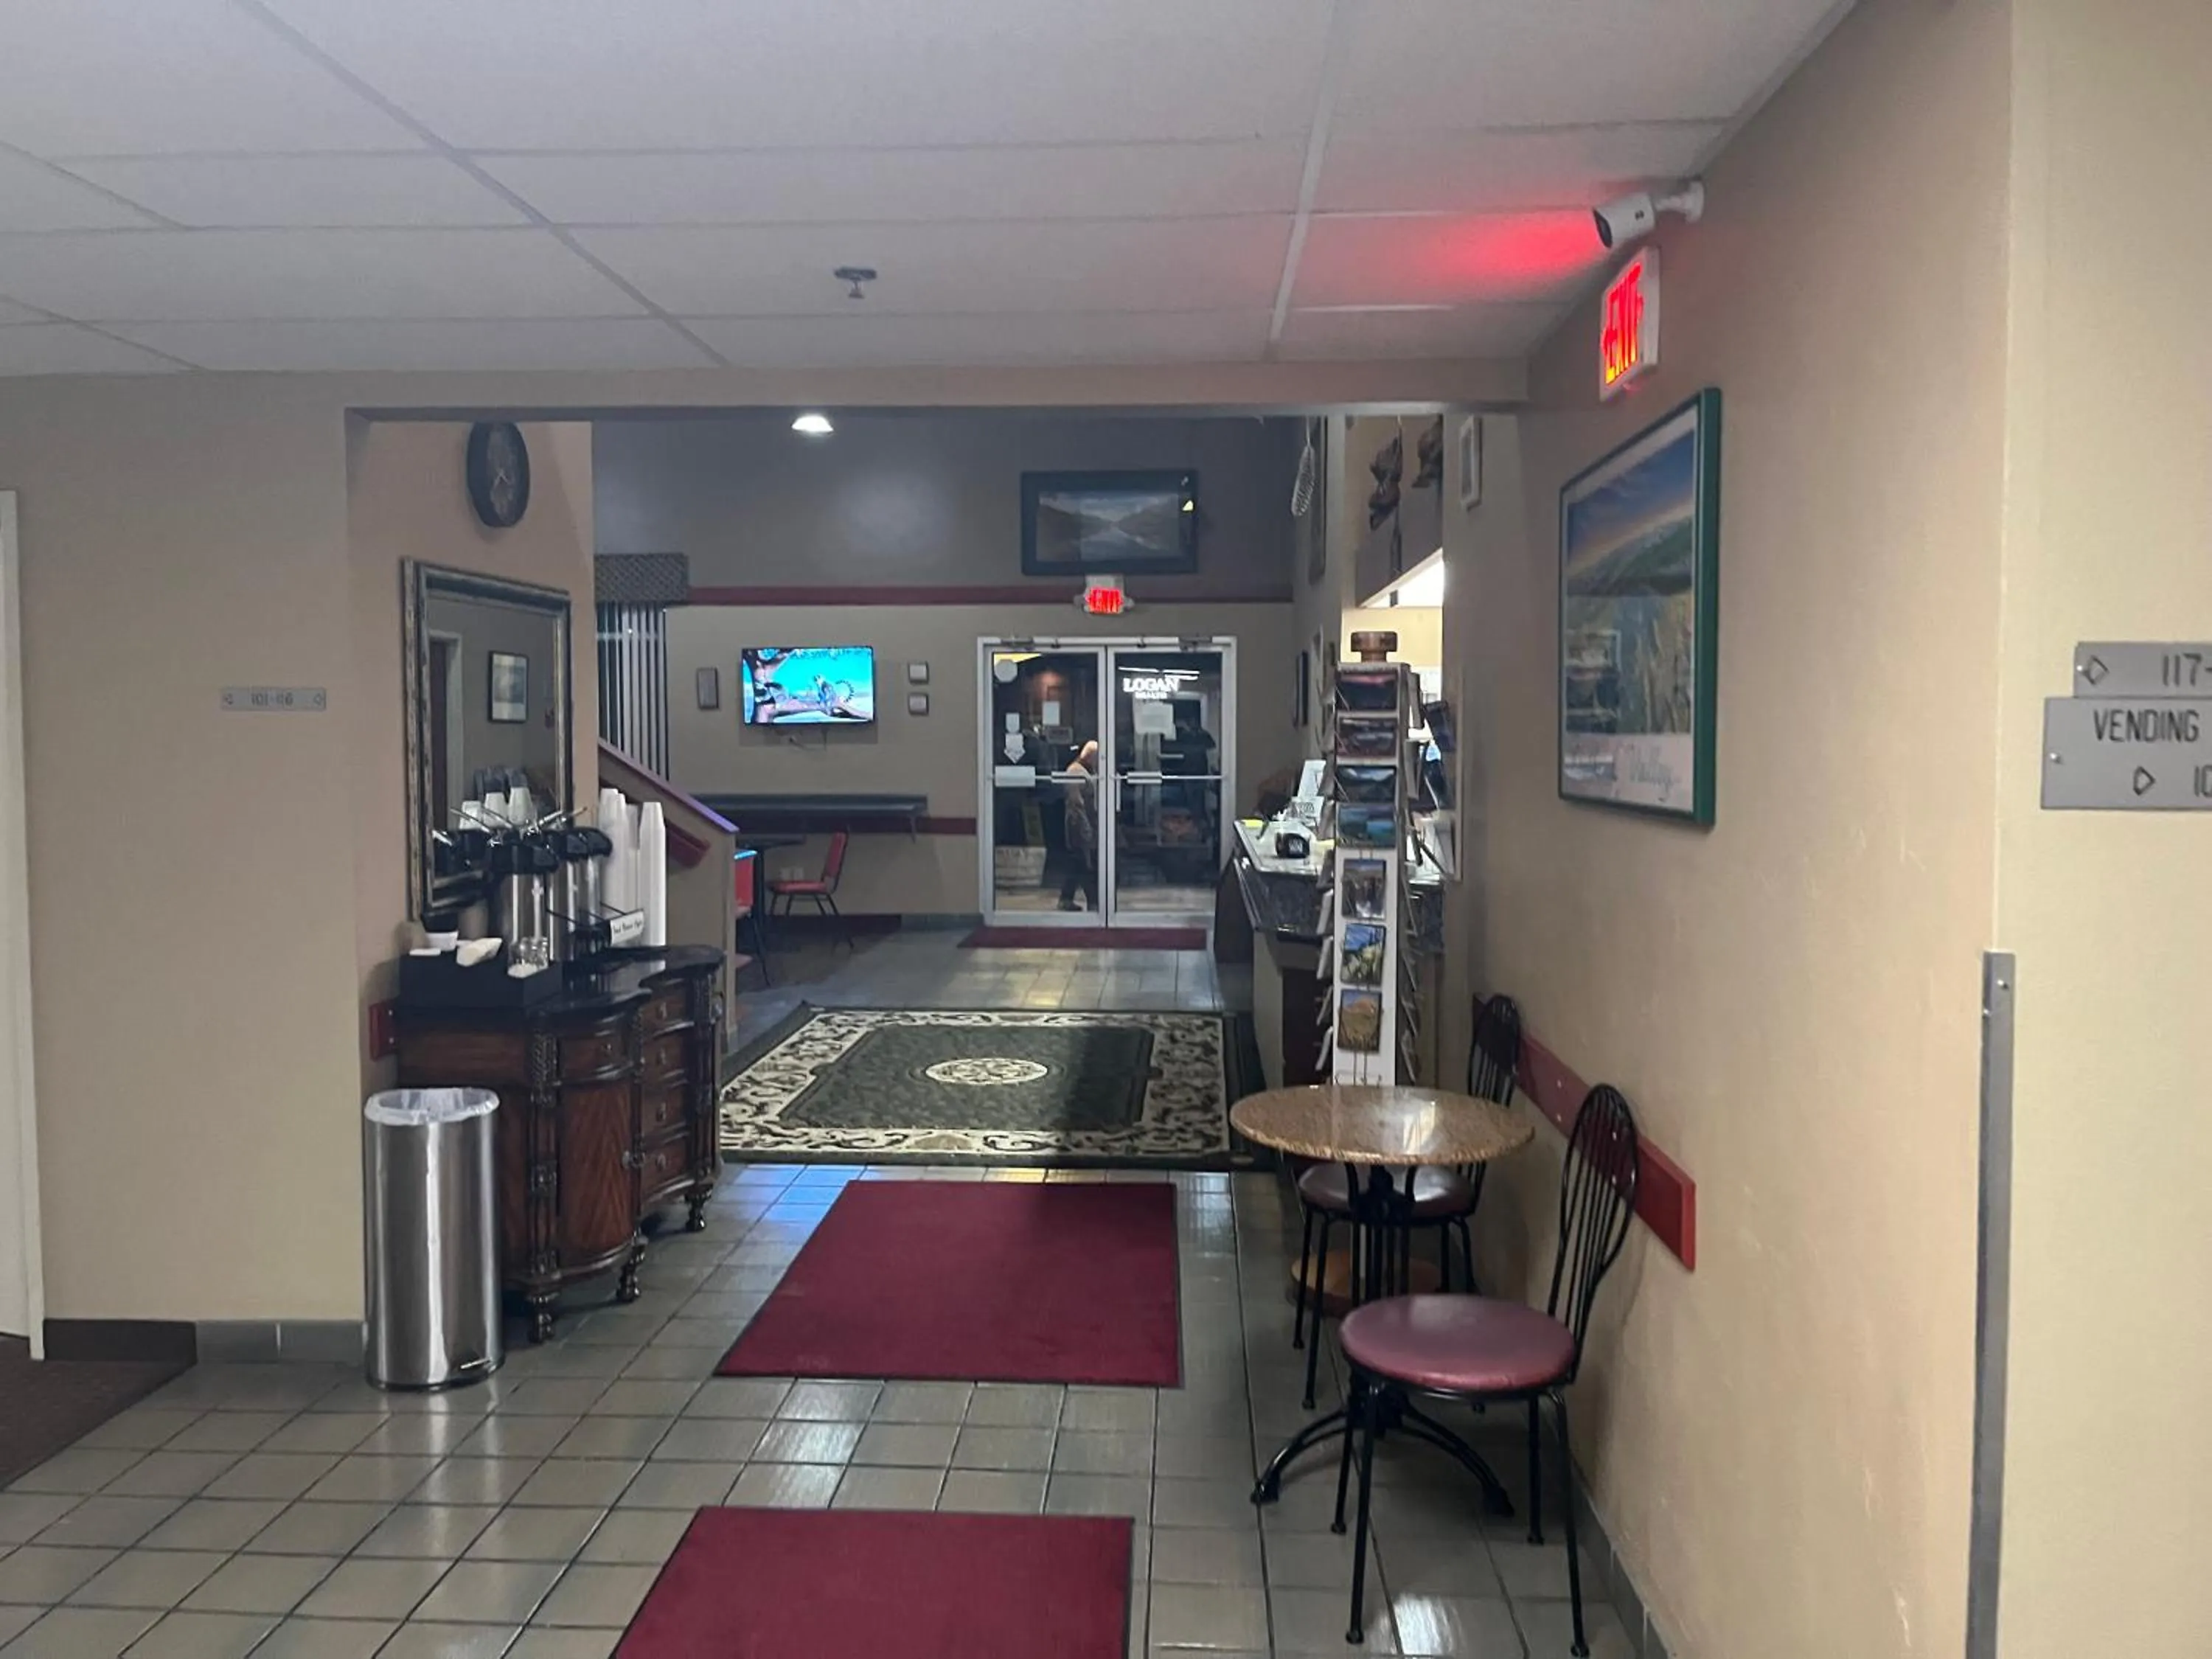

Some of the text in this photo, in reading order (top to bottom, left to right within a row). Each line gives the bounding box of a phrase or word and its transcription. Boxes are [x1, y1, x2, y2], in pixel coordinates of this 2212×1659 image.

[1604, 263, 1643, 383] EXIT
[1089, 588, 1121, 613] EXIT
[1123, 675, 1180, 692] LOGAN
[2093, 709, 2199, 742] VENDING
